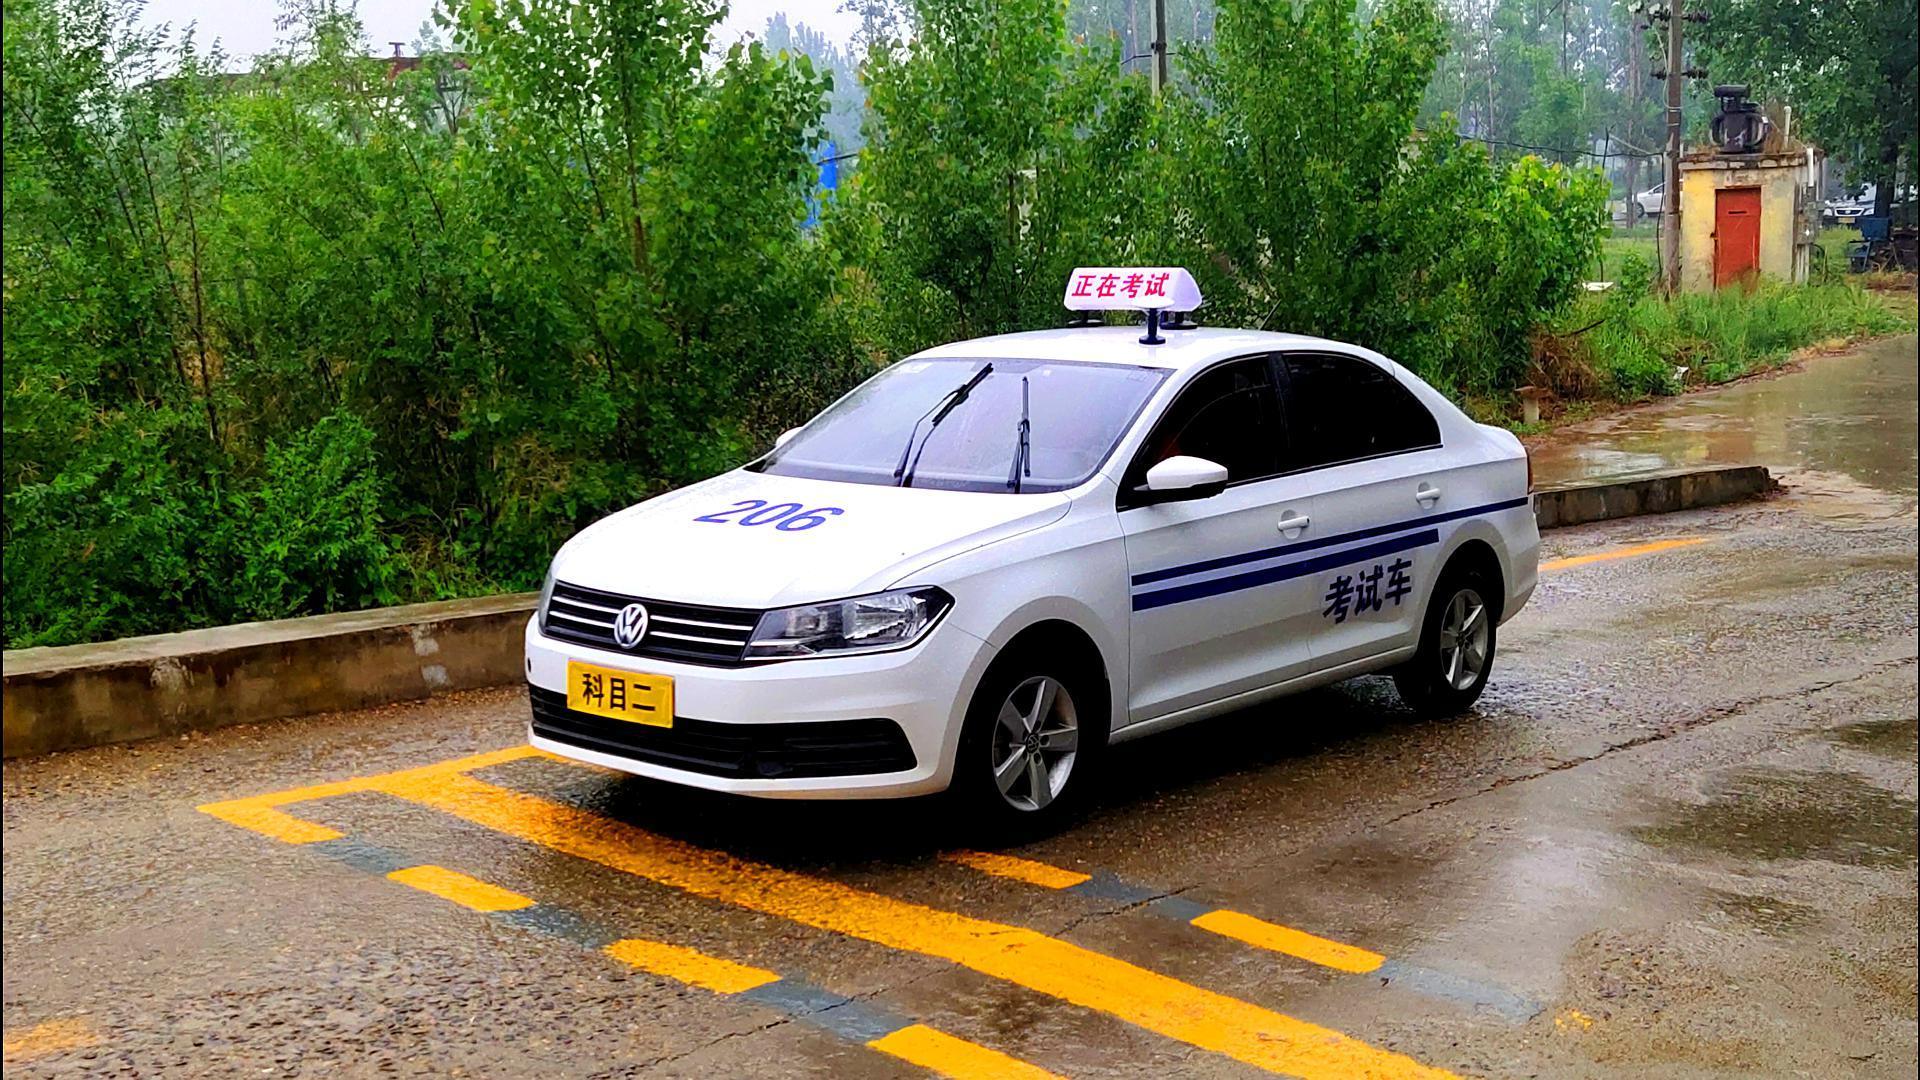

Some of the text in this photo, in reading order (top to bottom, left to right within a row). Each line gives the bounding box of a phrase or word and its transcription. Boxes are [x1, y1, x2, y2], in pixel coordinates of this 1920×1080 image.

[1071, 272, 1170, 299] 正在考试
[692, 499, 845, 531] 206
[1322, 558, 1412, 625] 考试车
[581, 673, 656, 712] 科目二
